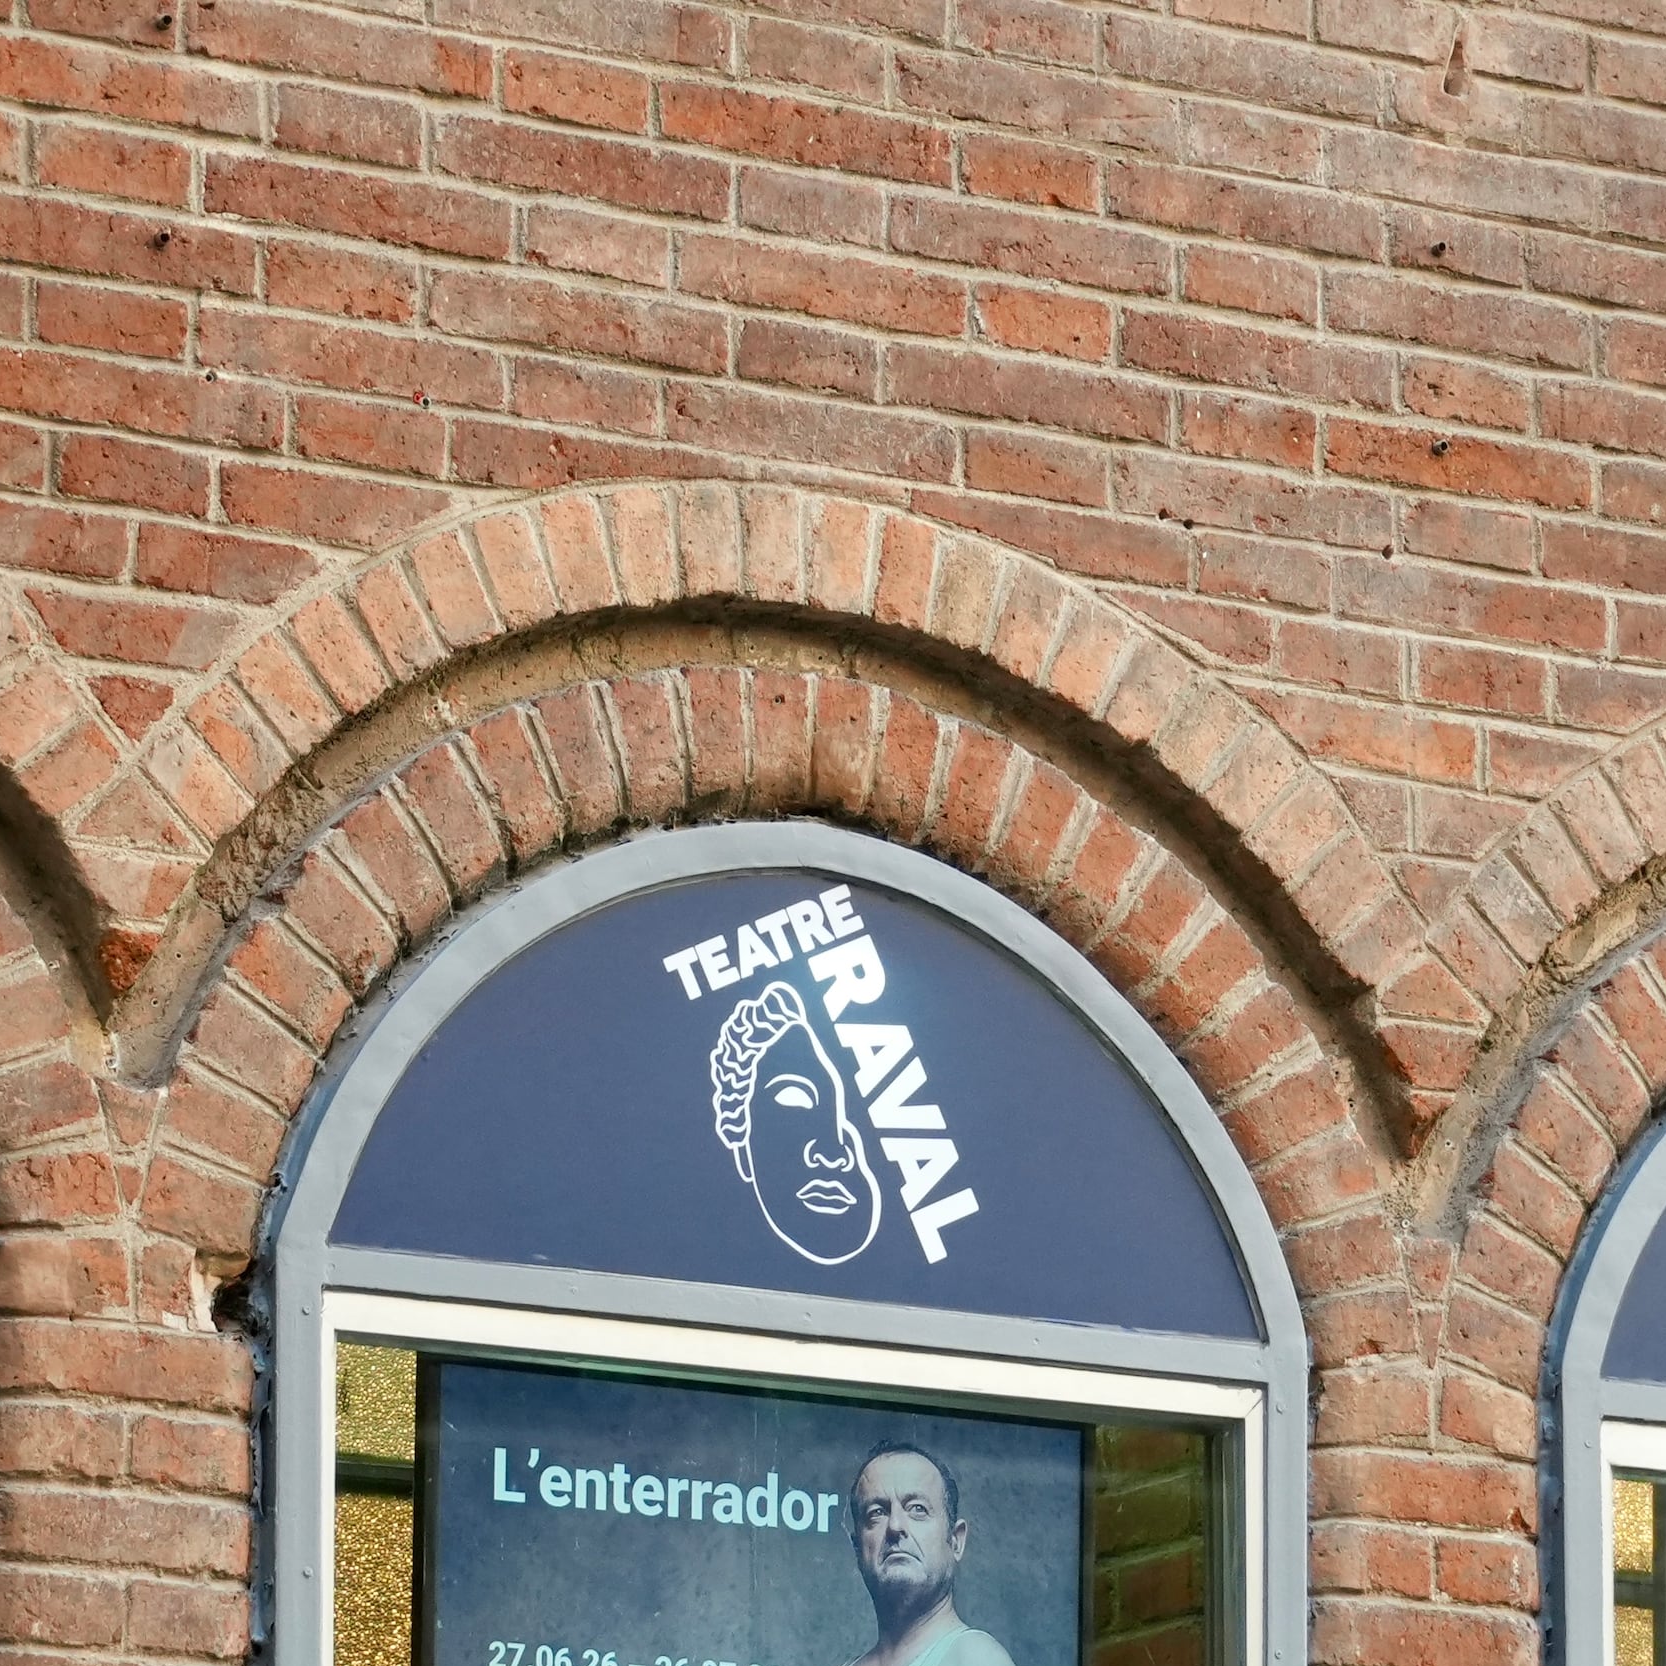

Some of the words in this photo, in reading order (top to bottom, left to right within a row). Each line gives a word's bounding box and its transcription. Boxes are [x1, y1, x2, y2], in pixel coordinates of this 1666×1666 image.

[662, 884, 865, 1001] TEATRE
[807, 933, 980, 1265] RAVAL
[492, 1446, 840, 1534] L'enterrador
